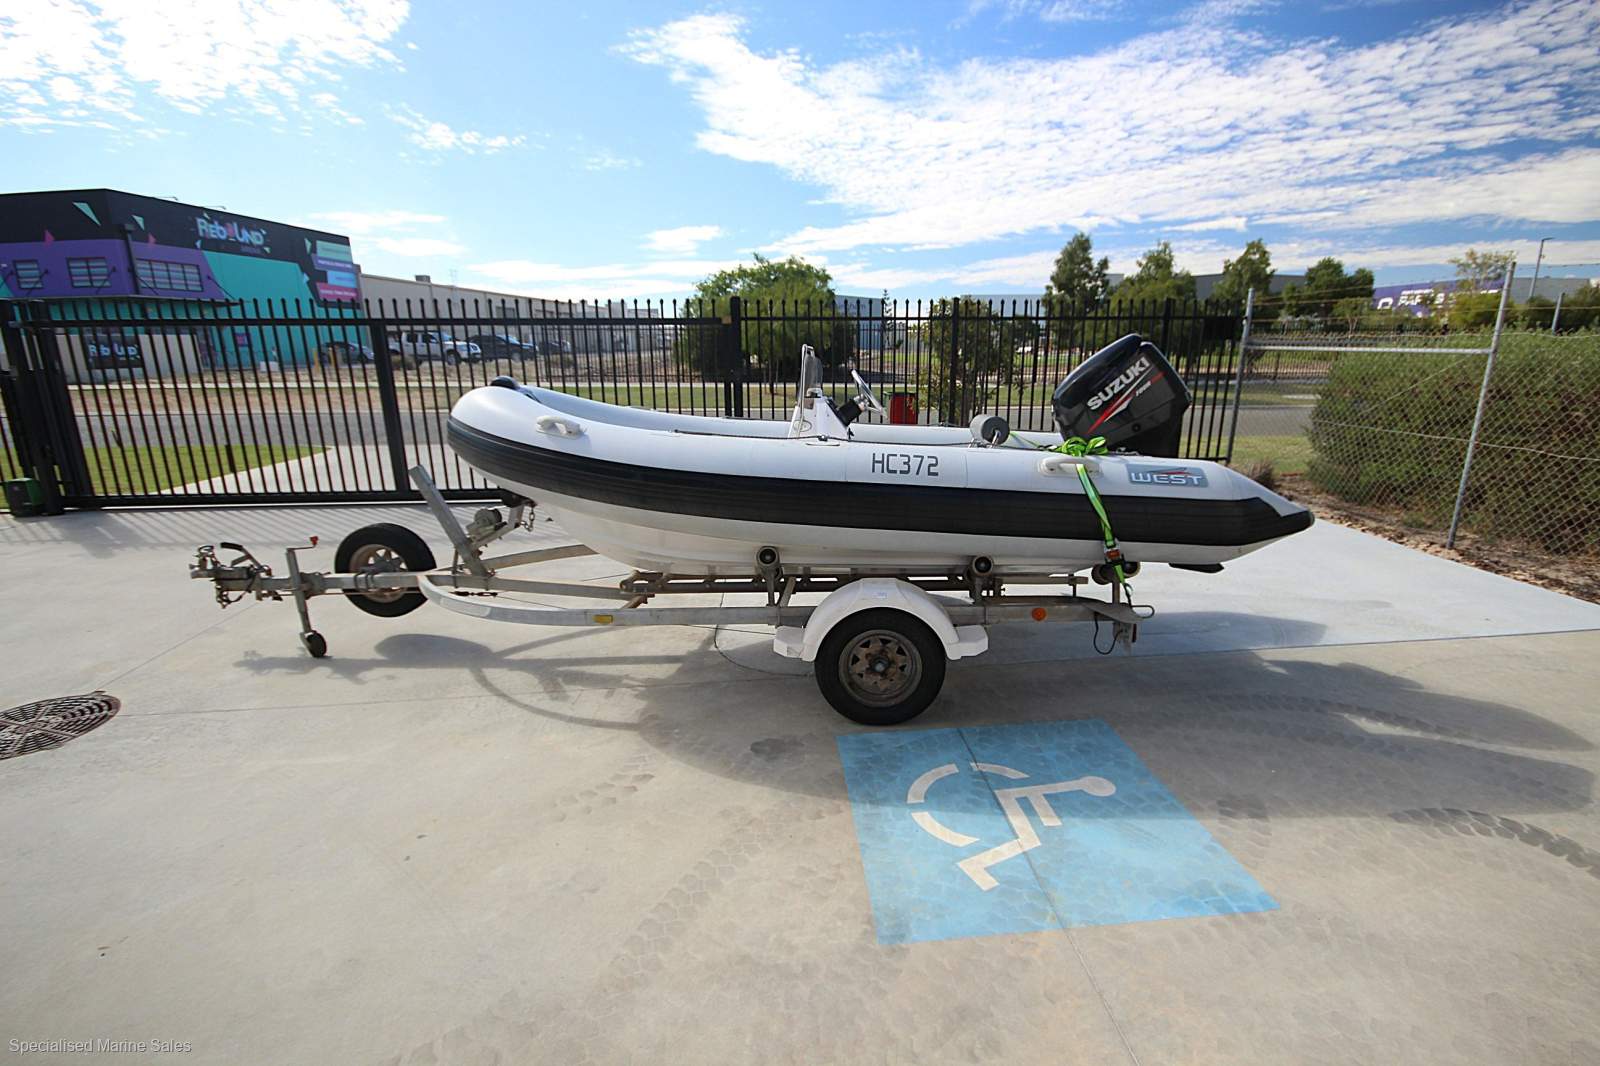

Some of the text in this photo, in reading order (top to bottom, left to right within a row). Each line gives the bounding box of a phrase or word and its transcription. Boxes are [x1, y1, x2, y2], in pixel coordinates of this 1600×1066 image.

[1086, 357, 1150, 410] SUZUKI
[872, 453, 939, 476] HC372
[1131, 472, 1202, 485] WEST
